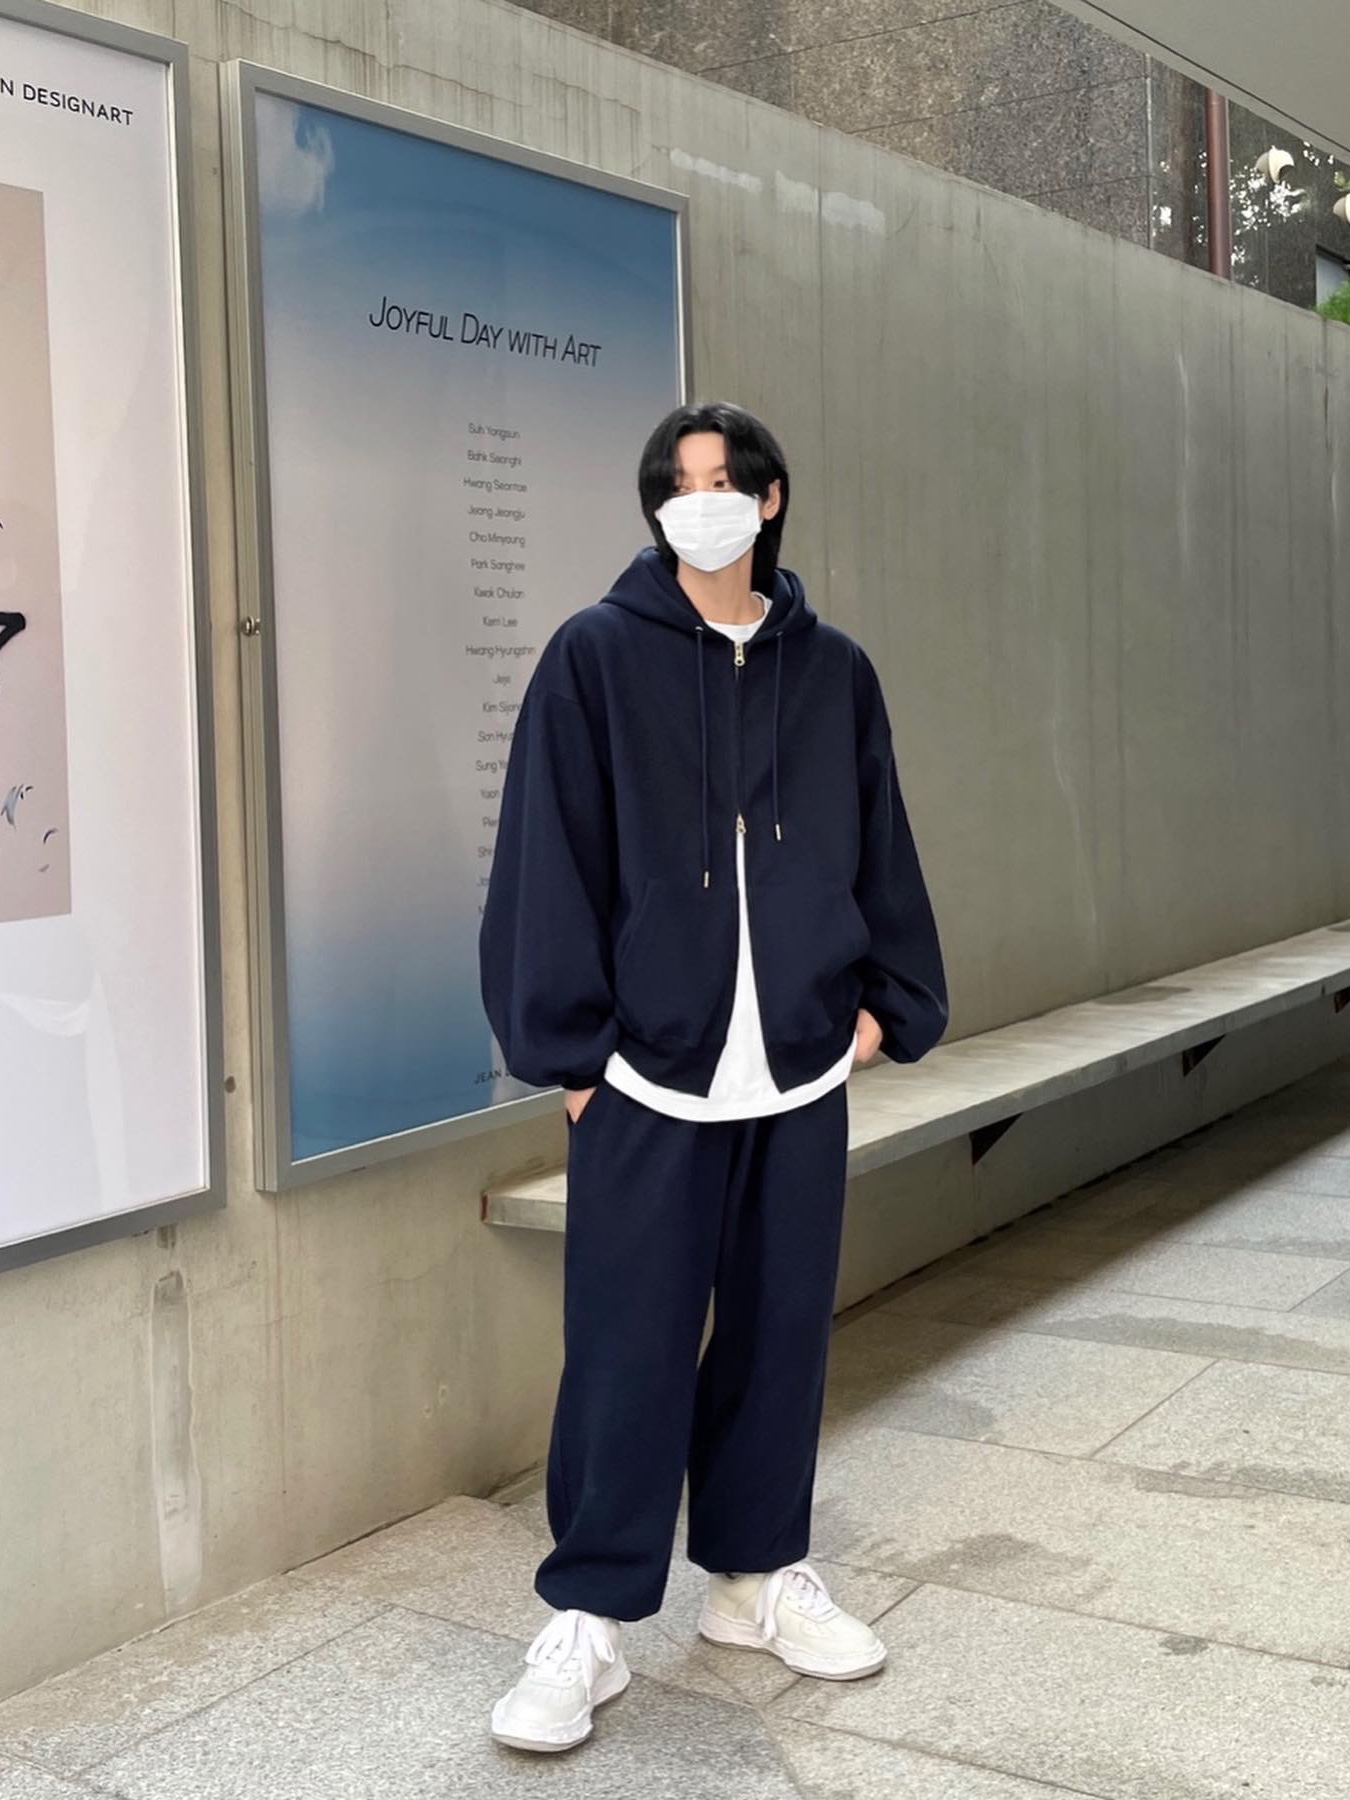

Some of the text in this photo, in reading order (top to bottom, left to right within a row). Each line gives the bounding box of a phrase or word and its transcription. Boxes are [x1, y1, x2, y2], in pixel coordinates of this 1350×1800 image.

[22, 83, 134, 126] DESIGNART
[369, 296, 602, 367] JOYFUL DAY WITH ART
[502, 615, 518, 627] Lee
[475, 759, 498, 774] Sung
[473, 1068, 502, 1085] JEAN
